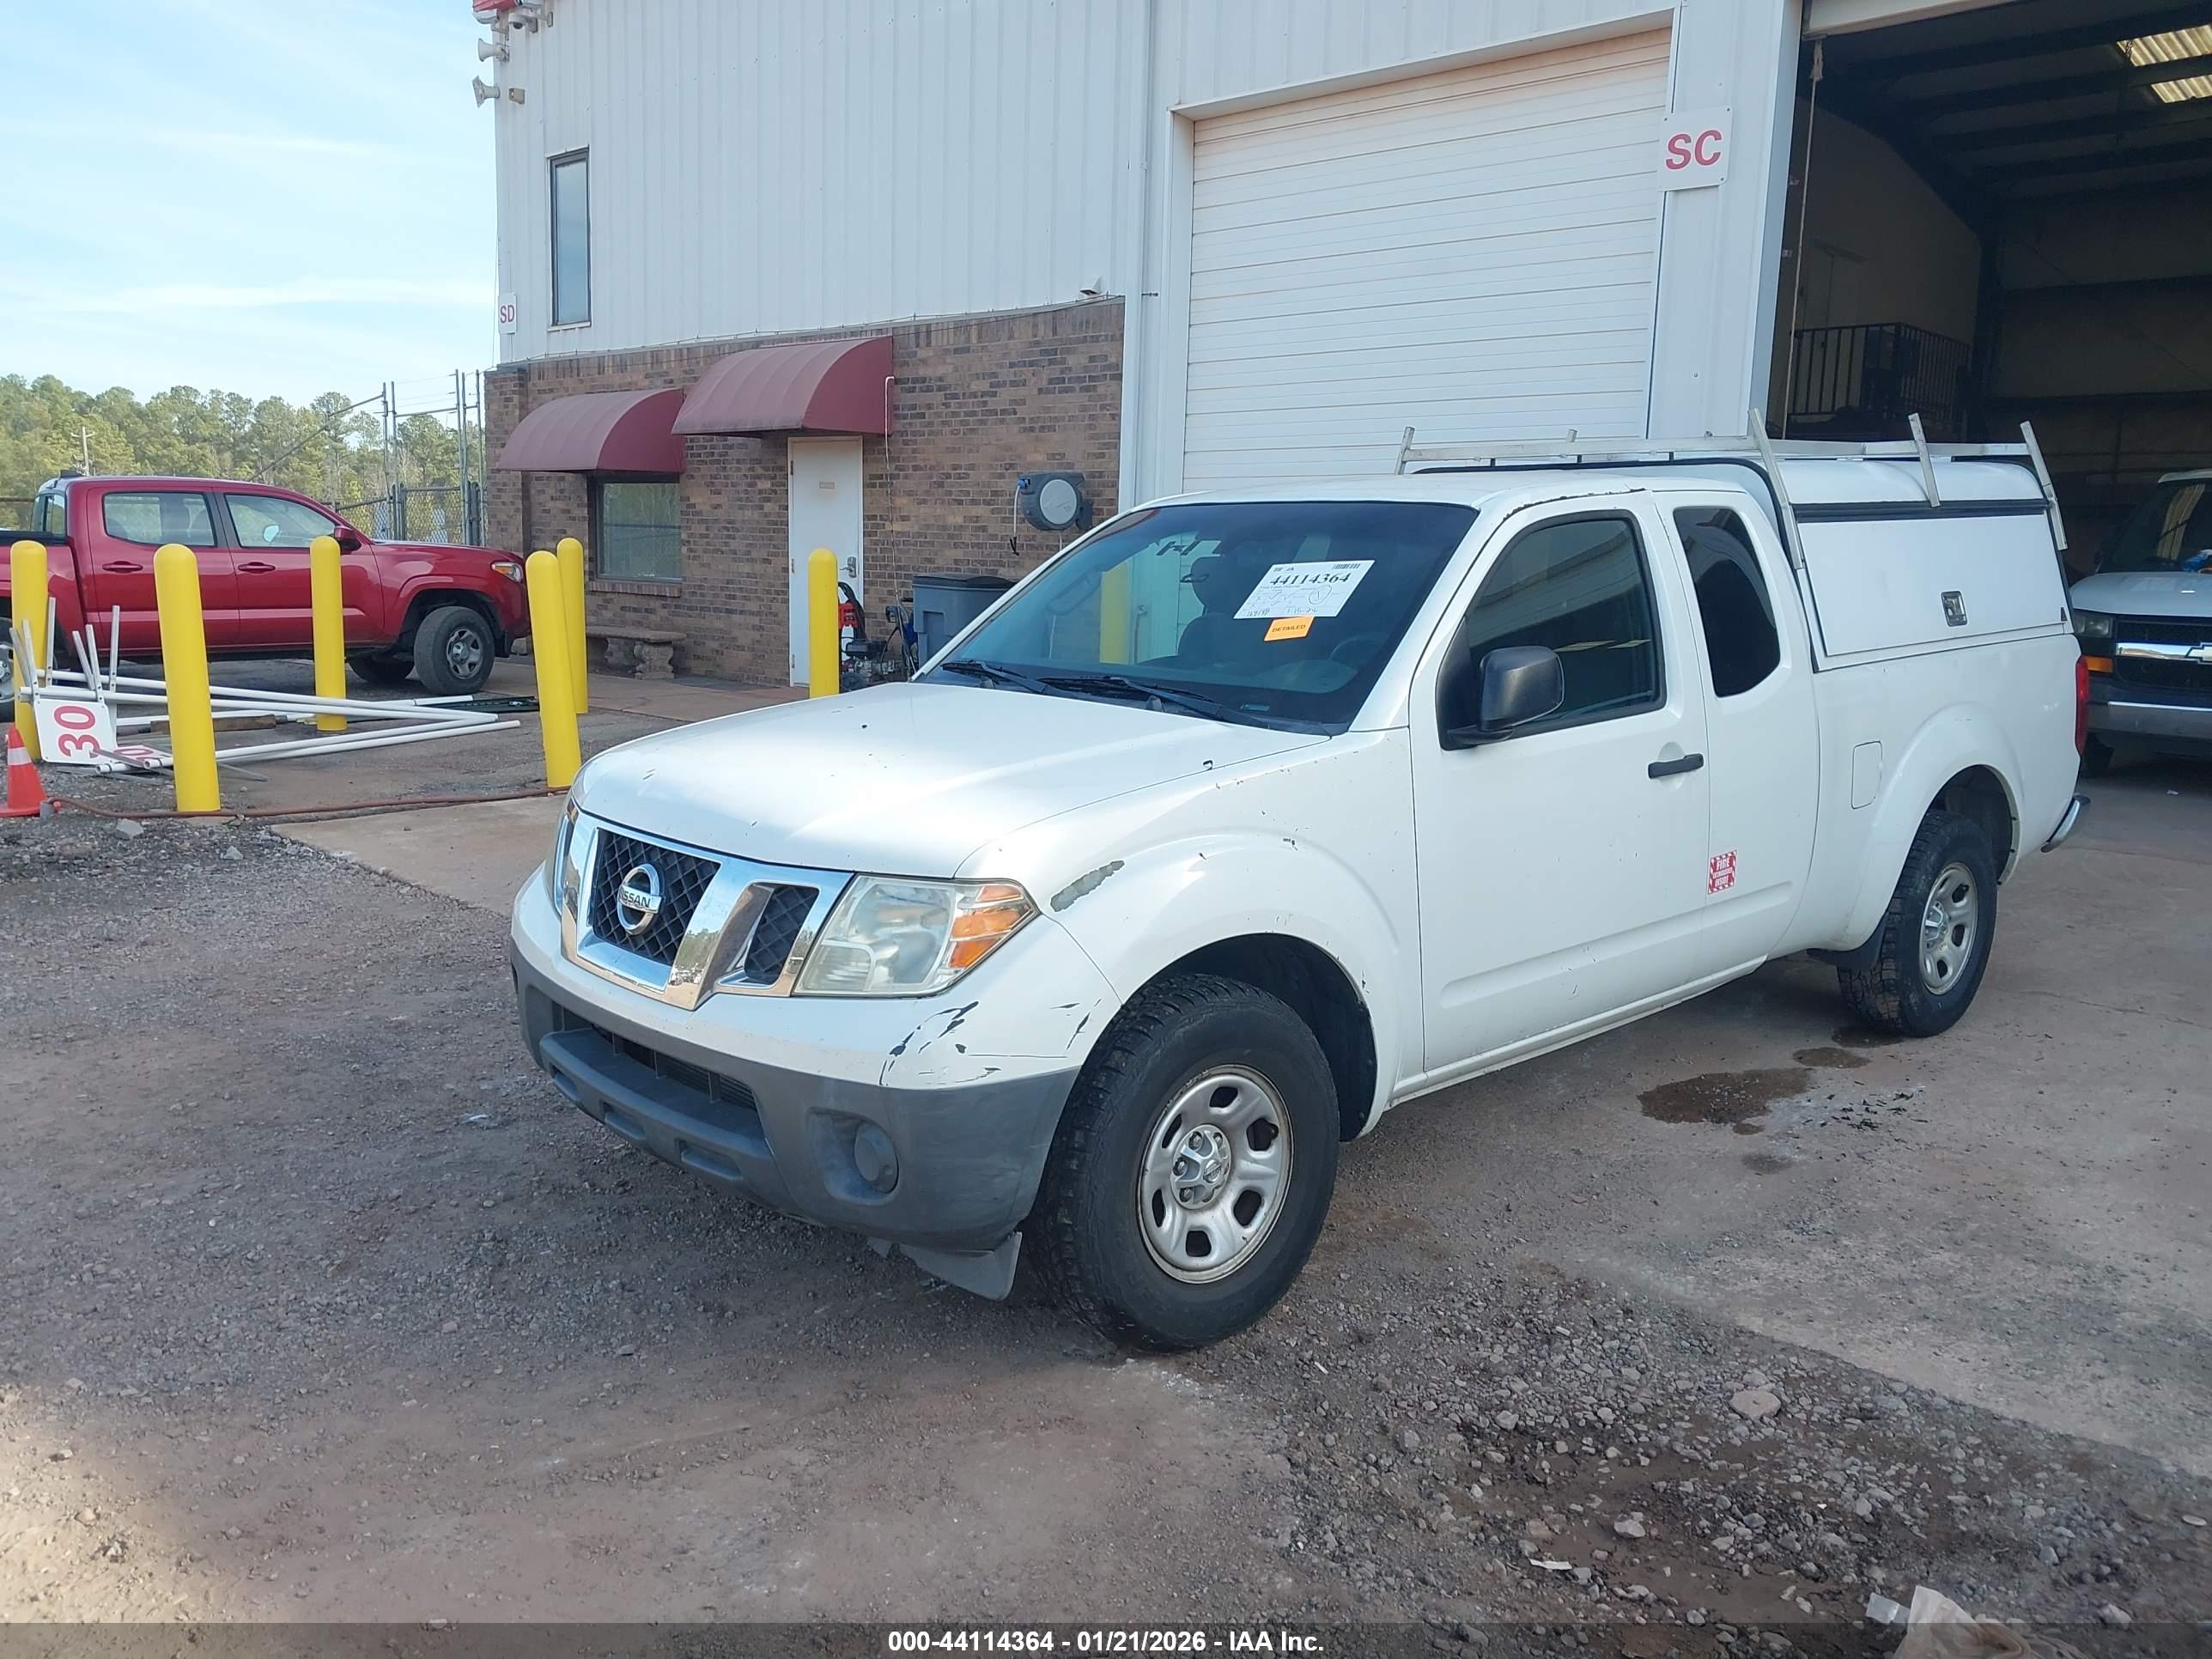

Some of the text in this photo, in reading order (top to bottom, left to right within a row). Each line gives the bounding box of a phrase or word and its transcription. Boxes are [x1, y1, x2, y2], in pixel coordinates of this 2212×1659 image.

[1666, 130, 1722, 170] SC
[500, 304, 515, 324] SD
[1270, 572, 1352, 586] 44114364
[1271, 624, 1306, 633] DETAILED
[53, 705, 100, 759] 30
[618, 886, 651, 908] NISSAN
